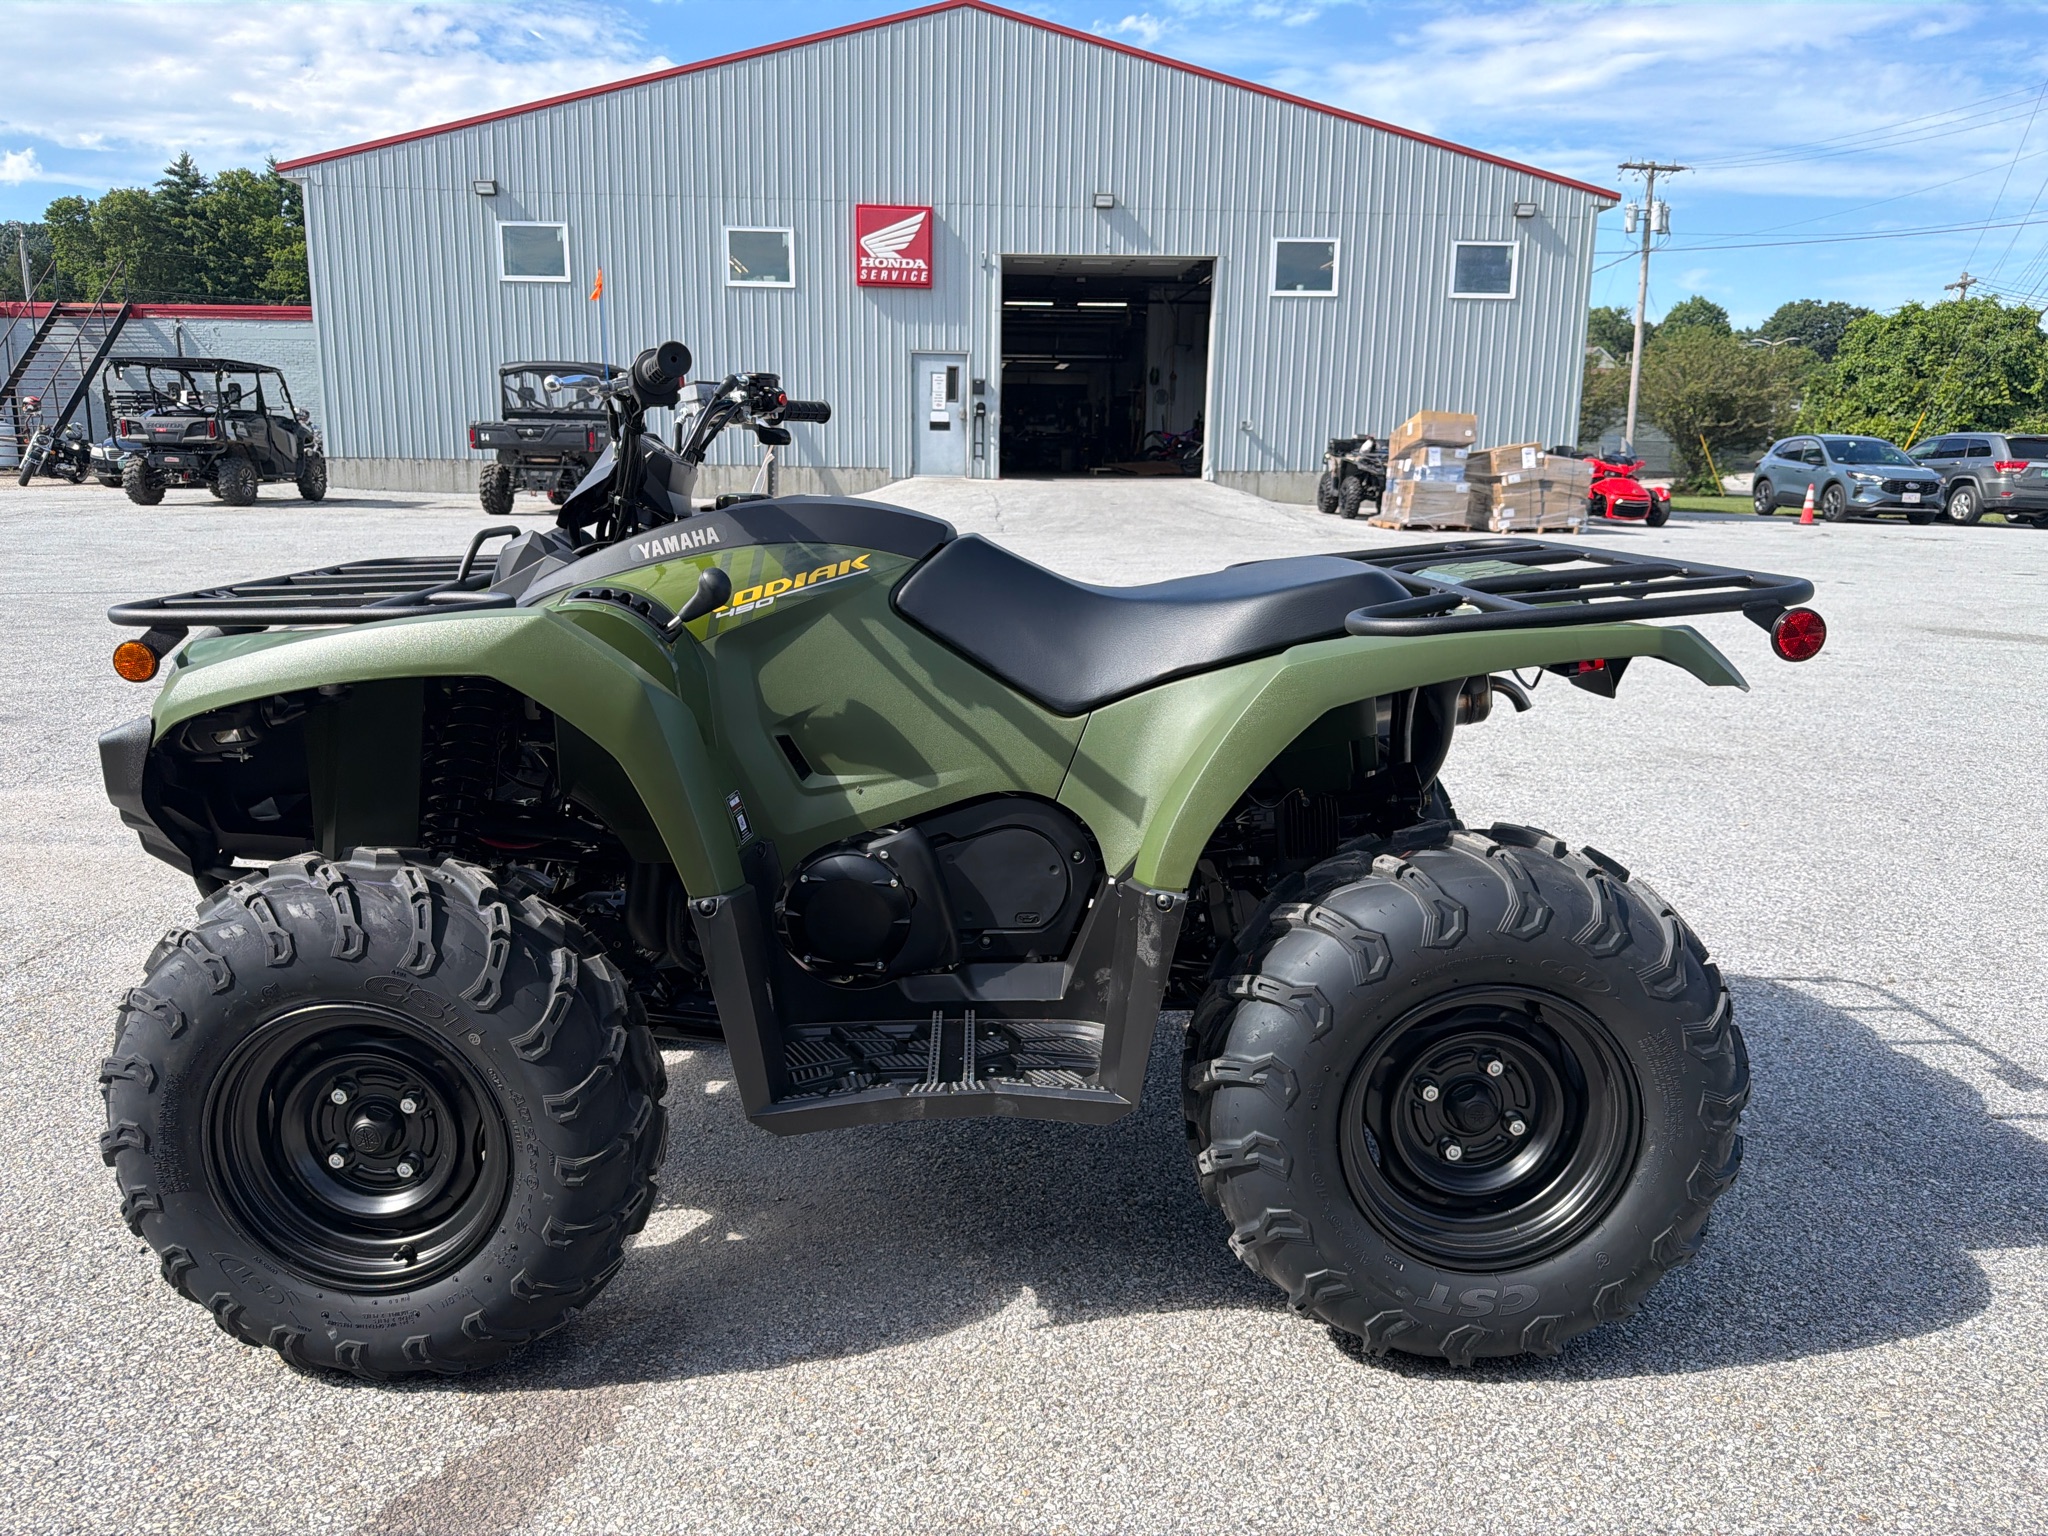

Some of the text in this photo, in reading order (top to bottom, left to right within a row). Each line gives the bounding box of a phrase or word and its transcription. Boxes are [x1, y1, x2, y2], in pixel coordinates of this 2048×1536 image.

[860, 257, 928, 269] HONDA
[860, 269, 928, 281] SERVICE
[638, 527, 720, 559] YAMAHA
[713, 554, 871, 613] ODIAK
[716, 597, 775, 618] 450
[364, 976, 486, 1036] CST
[1414, 1282, 1539, 1317] CST
